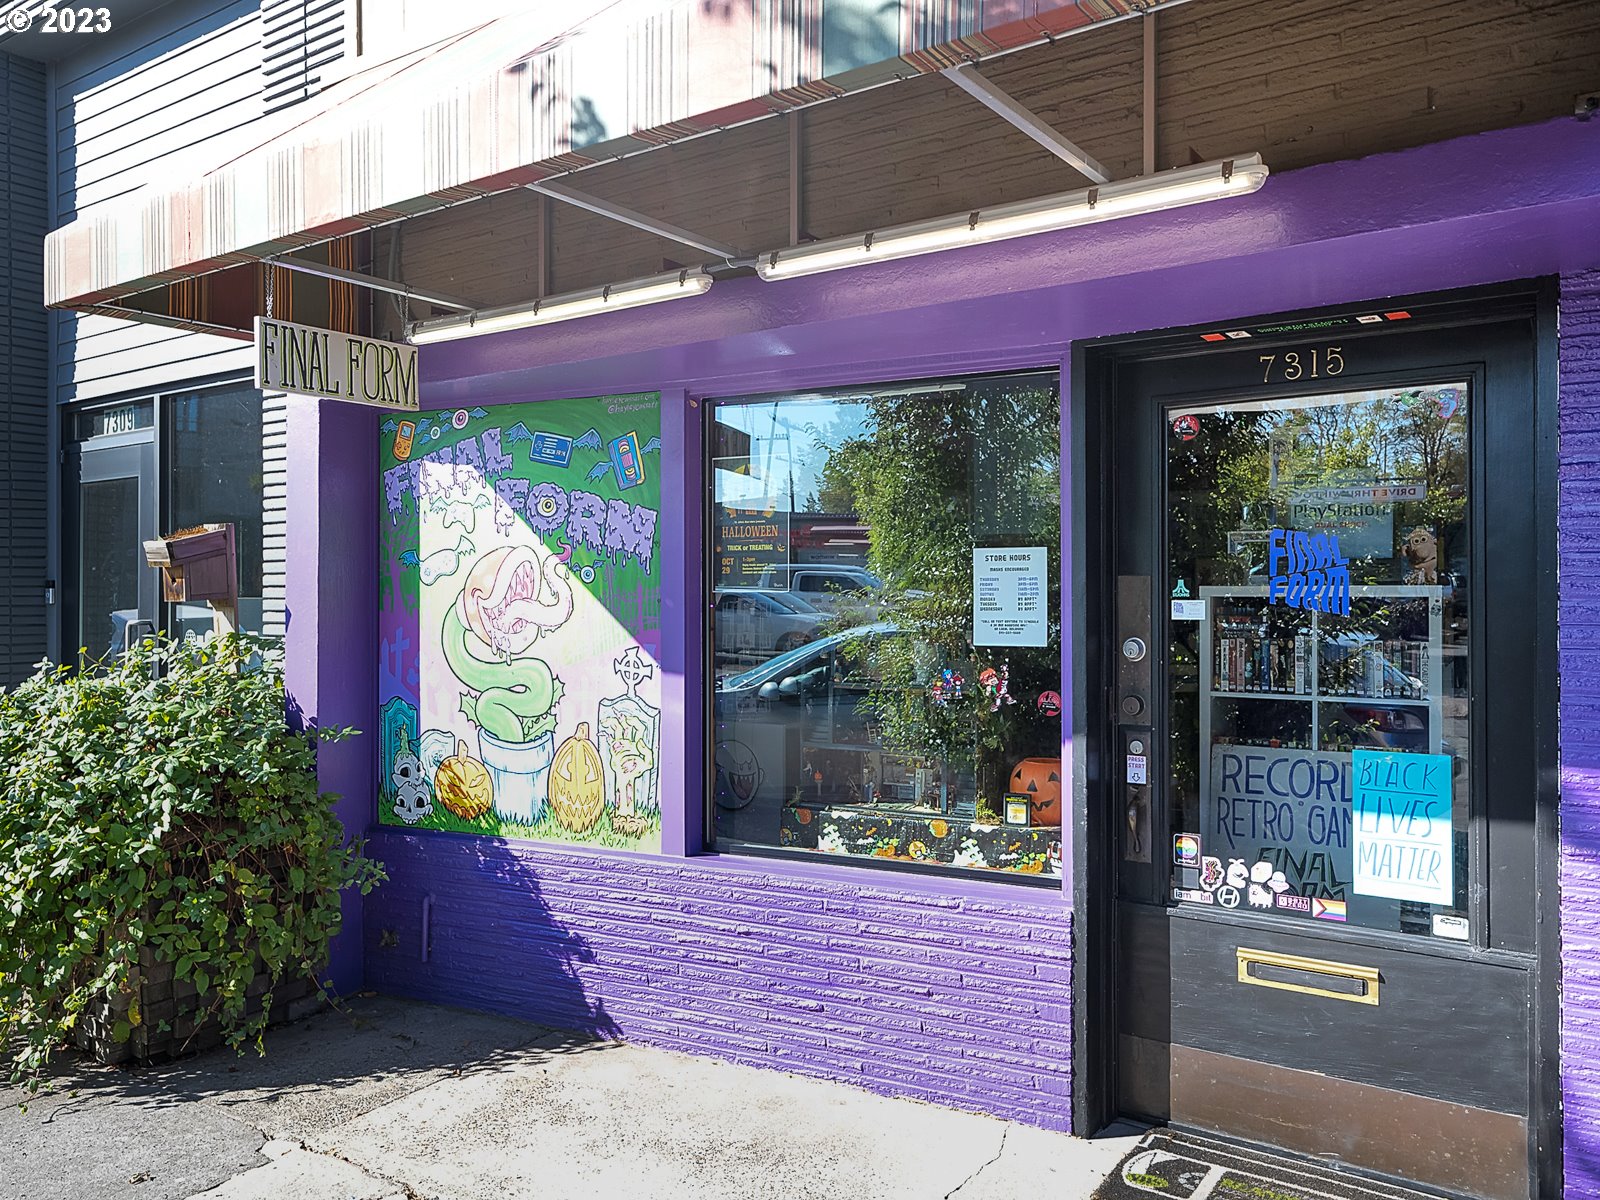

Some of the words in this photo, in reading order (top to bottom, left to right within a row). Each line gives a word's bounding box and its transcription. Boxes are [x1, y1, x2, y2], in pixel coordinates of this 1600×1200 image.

[262, 321, 340, 396] FINAL
[346, 338, 418, 407] FORM
[1259, 347, 1345, 383] 7315
[104, 407, 134, 434] 7309
[384, 427, 513, 526] FINAL
[494, 477, 658, 576] FORM
[721, 524, 779, 538] HALLOWEEN
[721, 557, 735, 566] OCT
[727, 544, 742, 552] TRICK
[749, 543, 774, 551] TREATING
[984, 554, 1007, 562] STORE
[1009, 554, 1031, 562] HOURS
[1270, 528, 1350, 577] FINAL
[721, 566, 731, 575] 29
[1269, 565, 1350, 618] FORM
[1359, 758, 1439, 791] BLACK
[1217, 797, 1294, 850] RETRO
[1359, 793, 1439, 838] LIVES
[1358, 841, 1441, 884] MATTER
[1175, 889, 1212, 902] iambit
